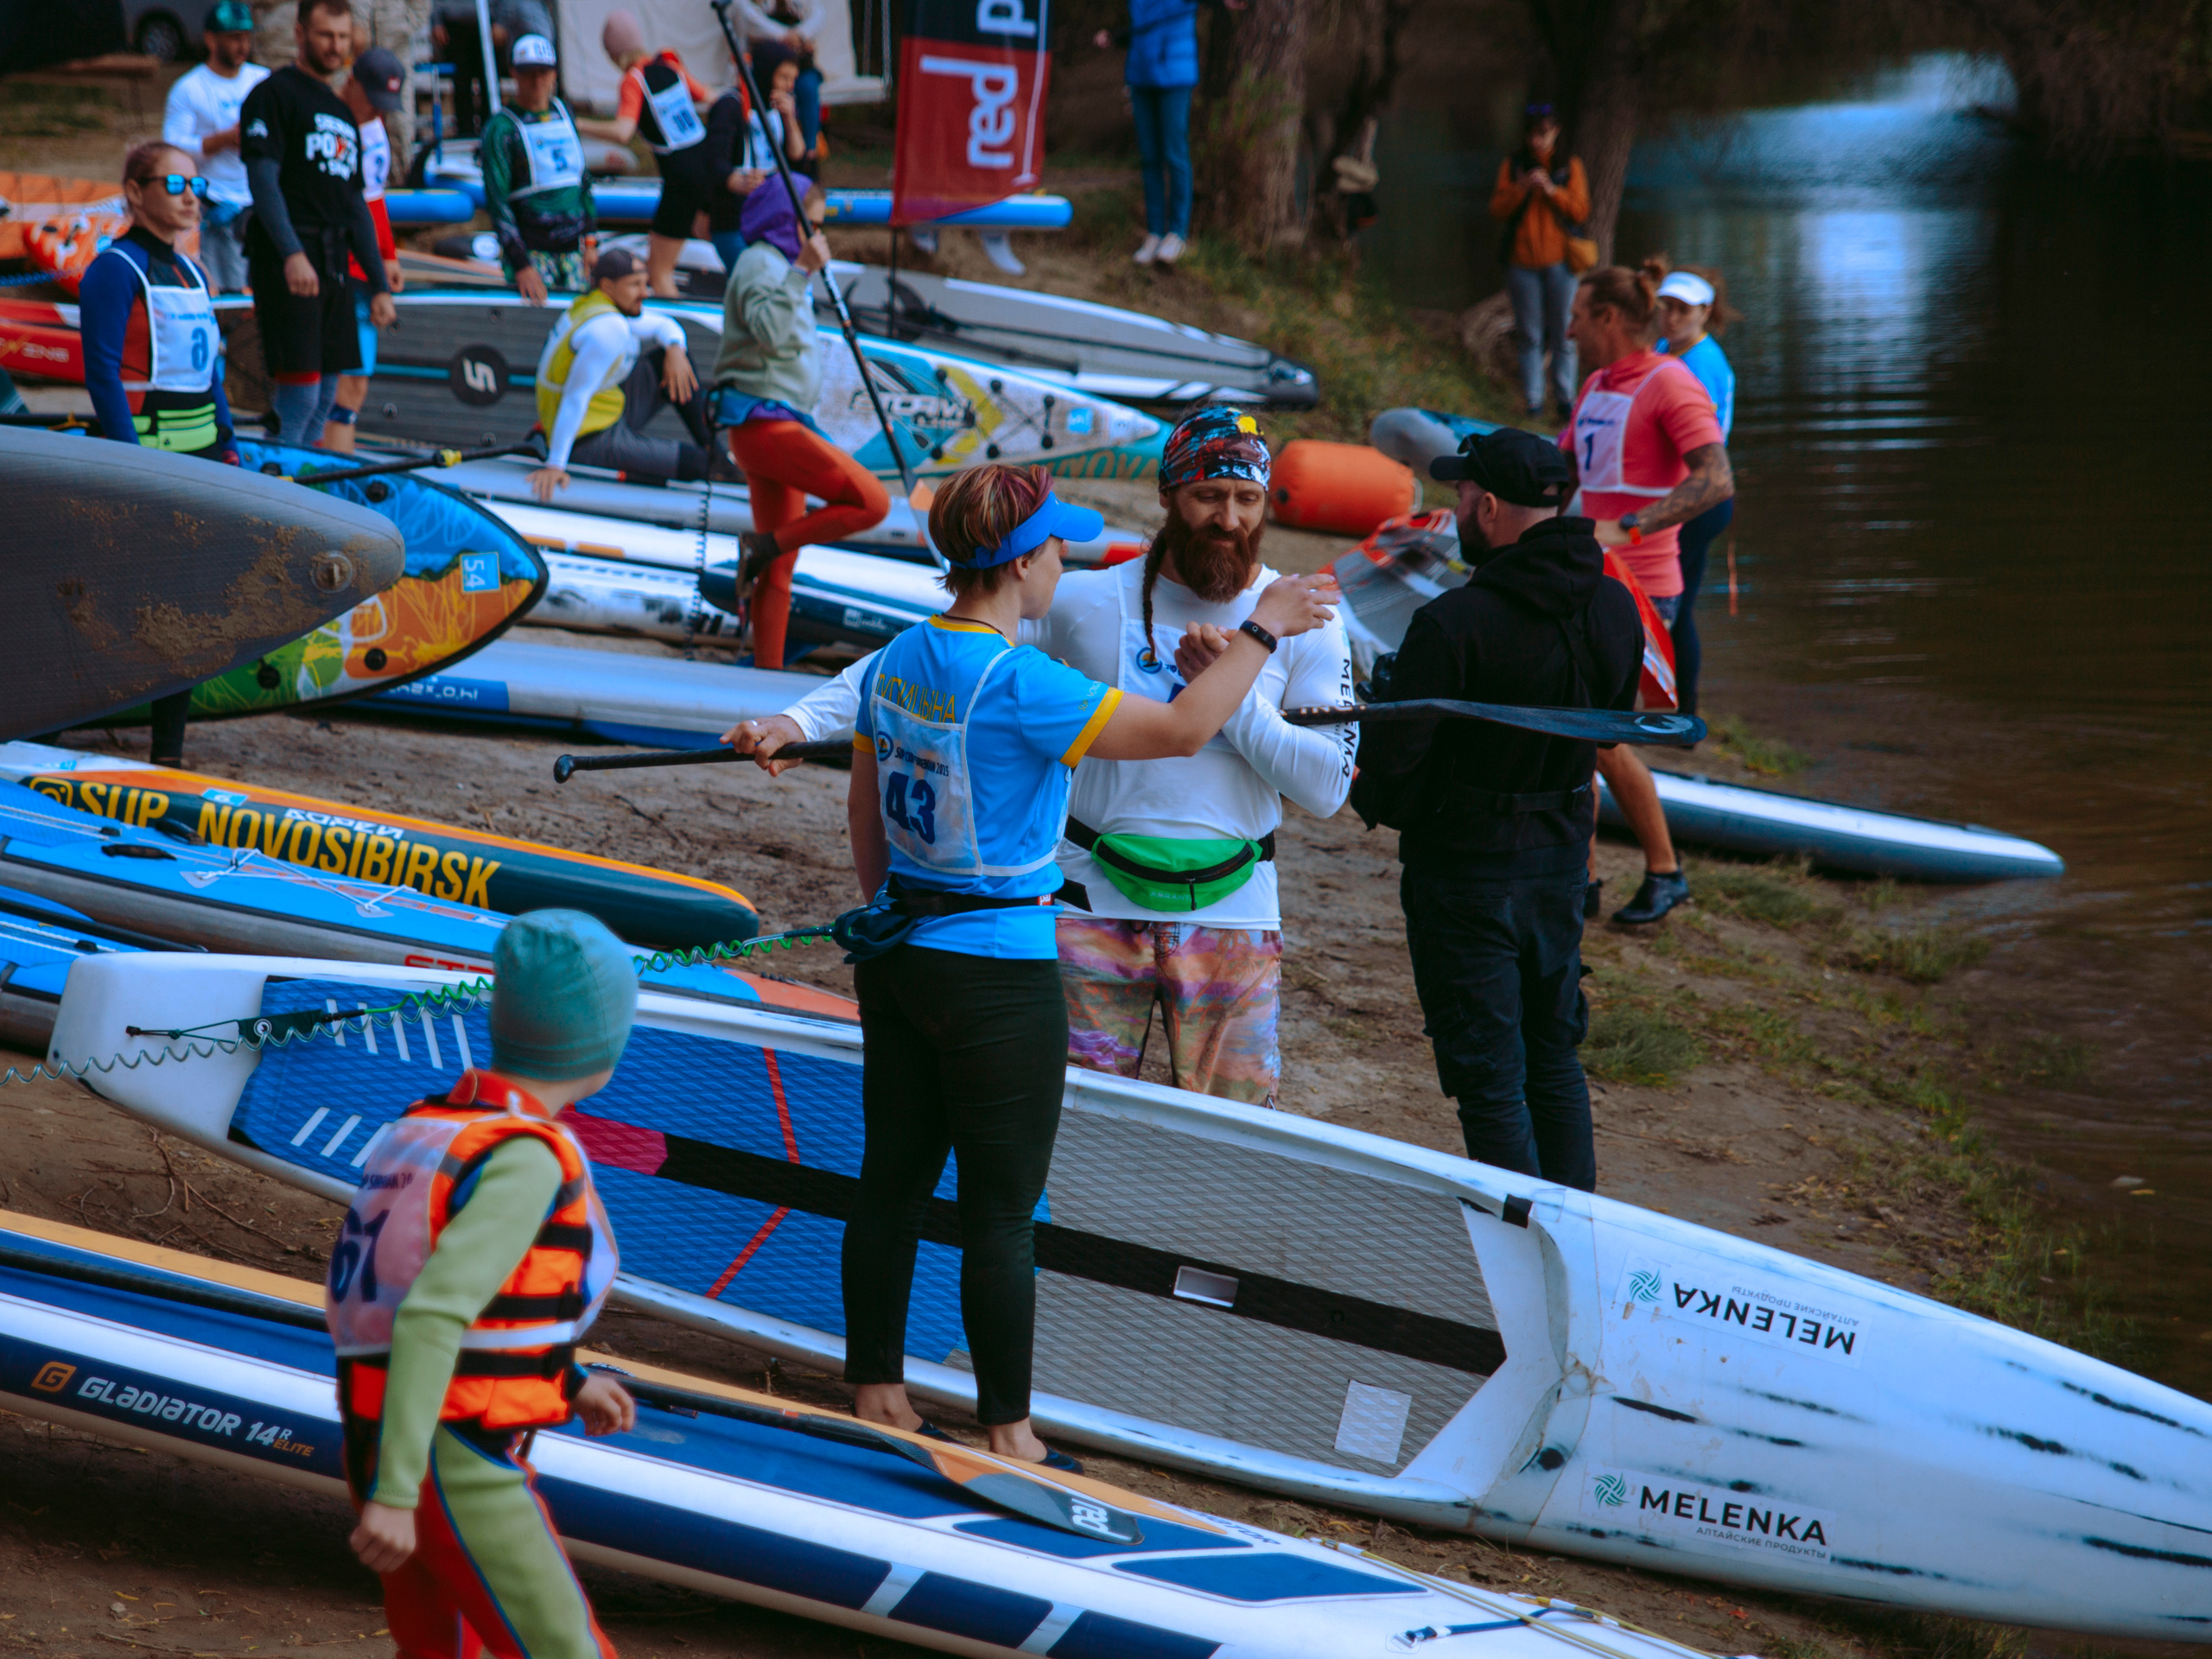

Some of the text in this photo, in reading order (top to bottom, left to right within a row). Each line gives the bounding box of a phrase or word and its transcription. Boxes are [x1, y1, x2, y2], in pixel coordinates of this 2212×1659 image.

[919, 54, 1018, 169] red
[1584, 433, 1594, 471] 1
[886, 771, 936, 844] 43
[1674, 1282, 1856, 1356] MELENKA
[1731, 1285, 1859, 1327] АЛТАЙСКИЕ ПРОДУКТЫ
[271, 1438, 315, 1458] ELITE
[1639, 1485, 1827, 1547] MELENKA
[1696, 1526, 1827, 1560] АЛТАЙСКИЕ ПРОДУКТЫ
